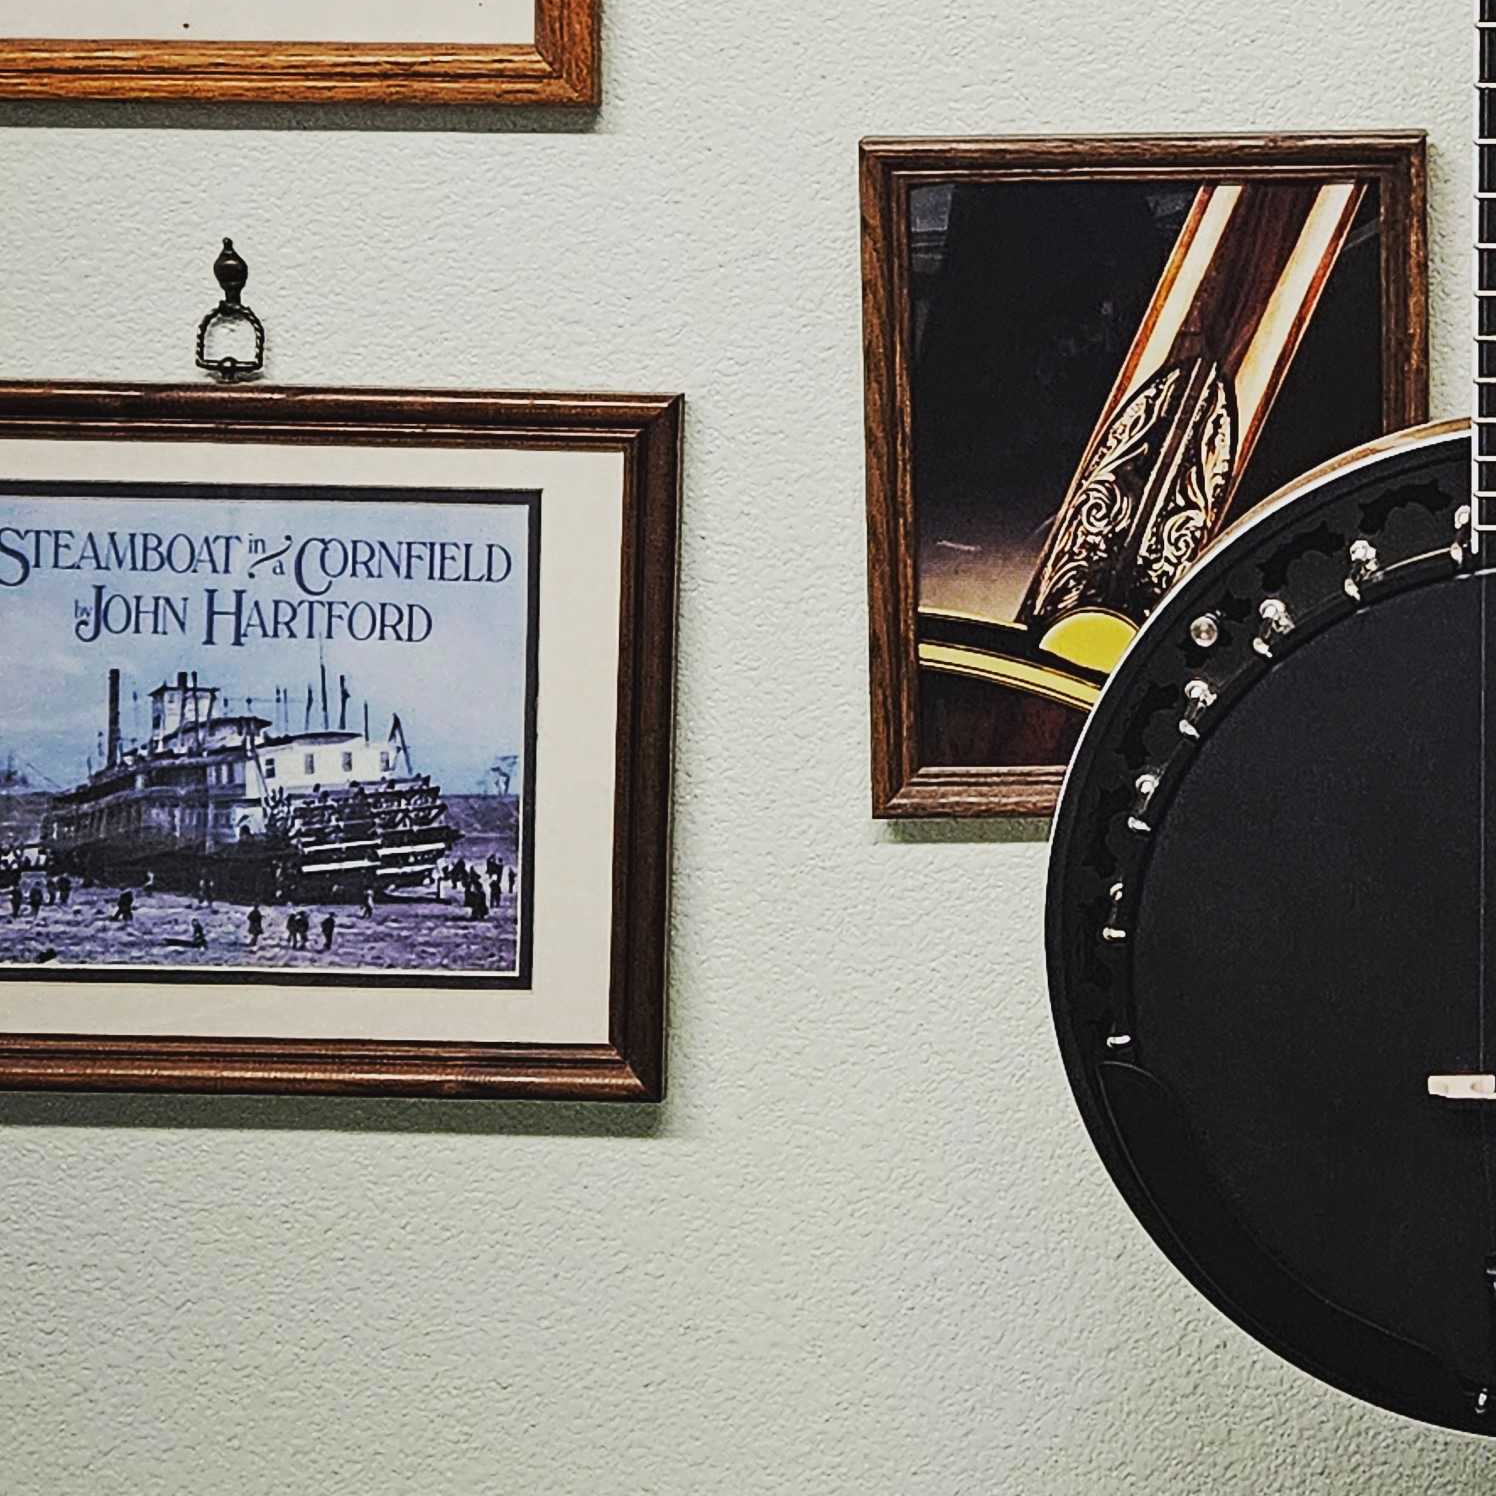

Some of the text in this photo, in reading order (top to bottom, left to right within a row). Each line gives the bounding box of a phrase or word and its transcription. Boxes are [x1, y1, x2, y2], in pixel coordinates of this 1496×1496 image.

[0, 527, 512, 596] STEAMBOAT in a CORNFIELD
[75, 584, 190, 642] JOHN
[202, 588, 433, 647] HARTFORD
